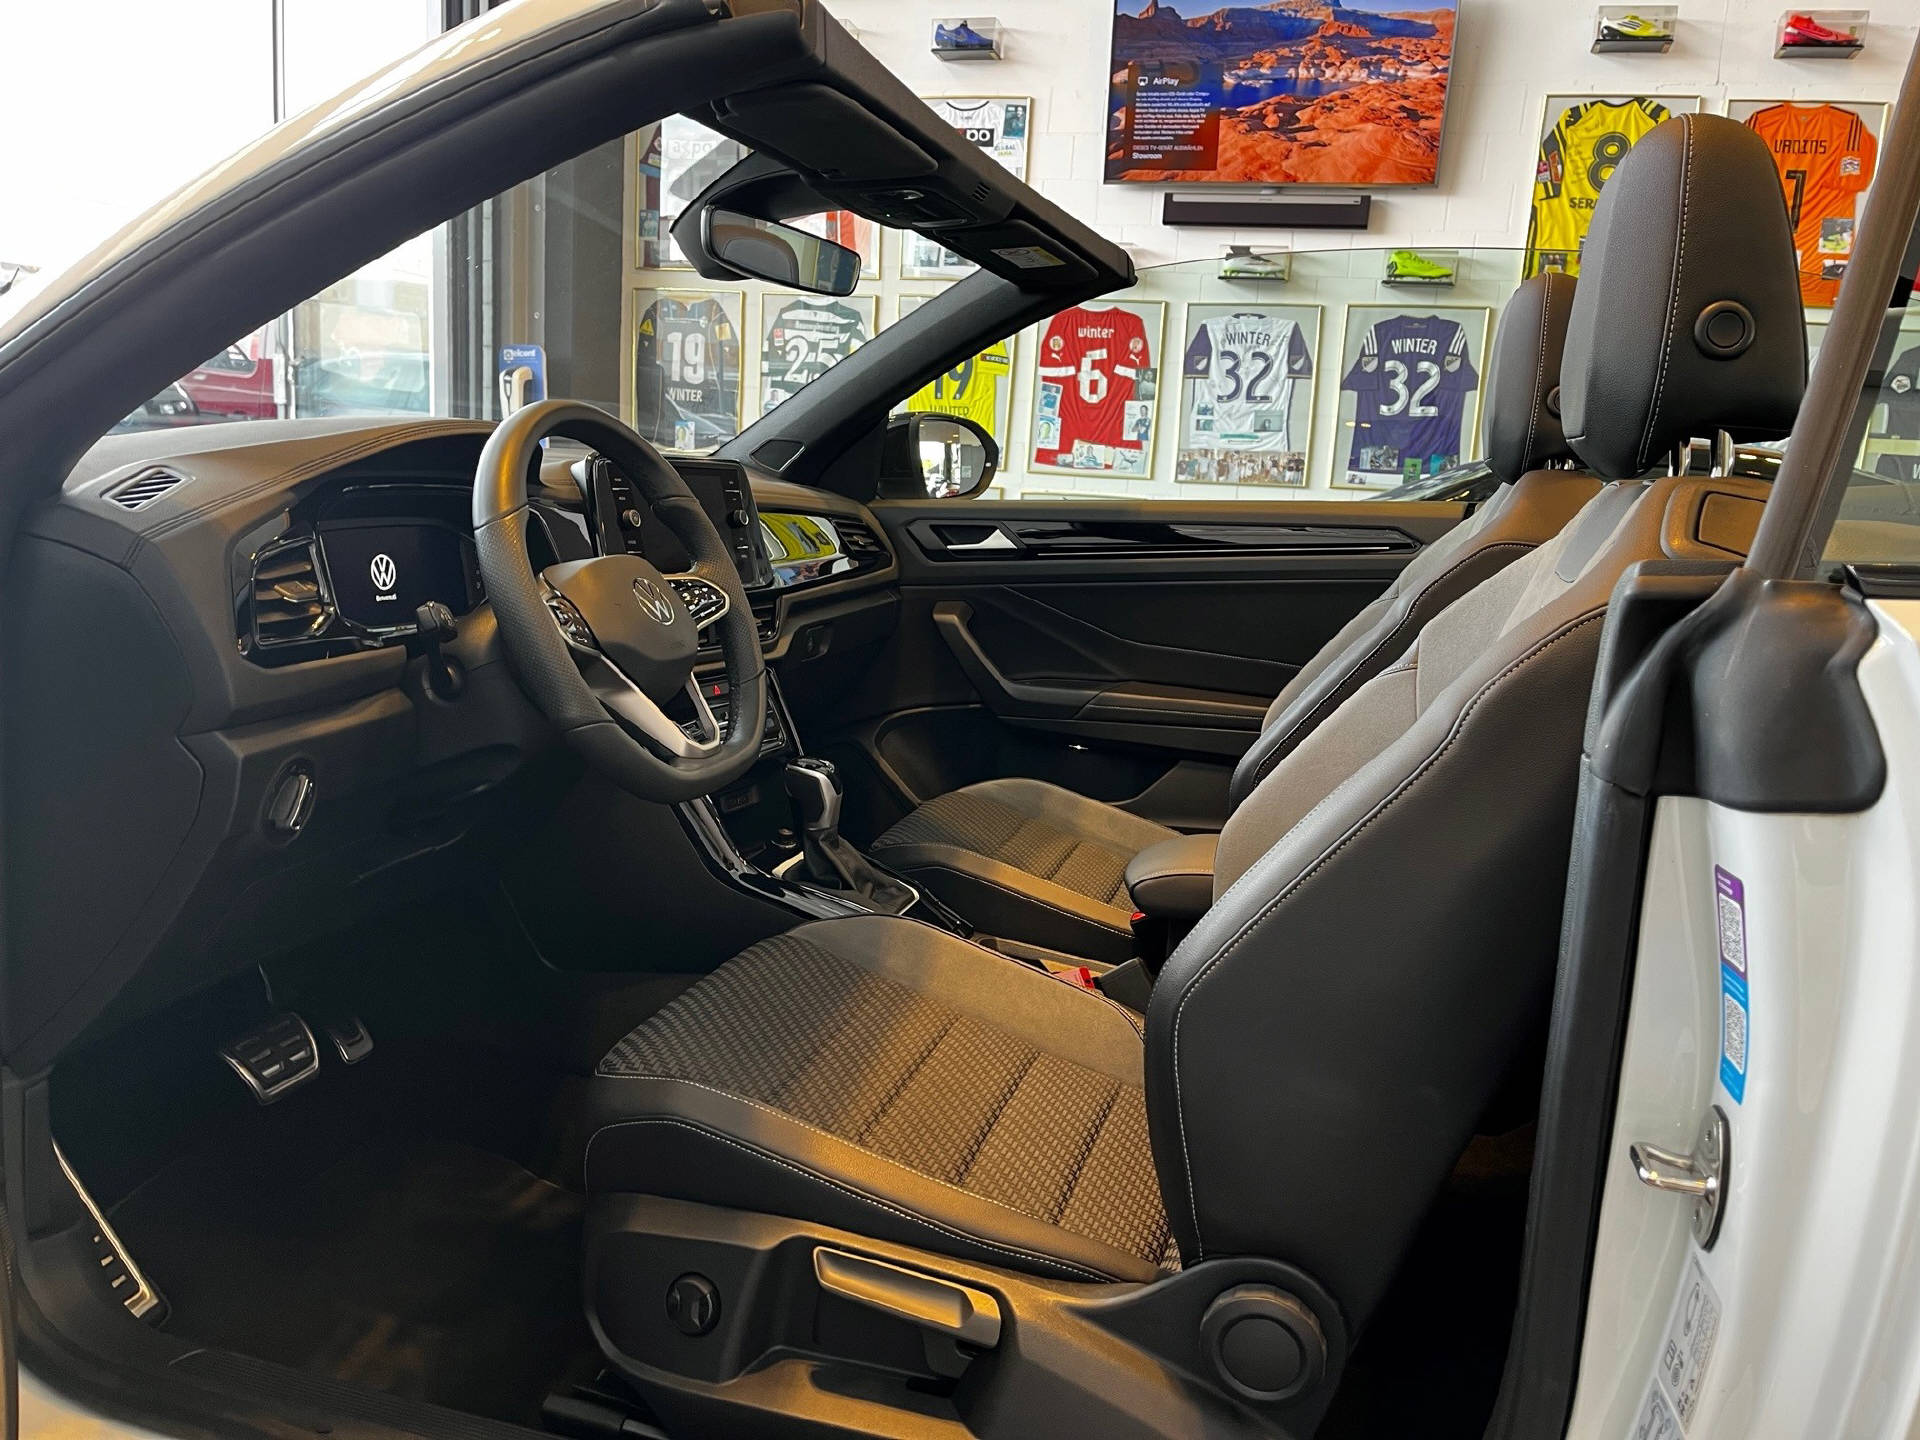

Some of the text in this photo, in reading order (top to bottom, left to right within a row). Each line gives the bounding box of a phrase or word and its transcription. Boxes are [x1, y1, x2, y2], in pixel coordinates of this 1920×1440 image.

[1153, 77, 1180, 87] AirPlay
[1132, 152, 1163, 160] Showroom
[1588, 132, 1632, 193] 8
[1785, 169, 1807, 234] 7
[1078, 327, 1115, 339] winter
[1226, 331, 1271, 347] WINTER
[1391, 338, 1438, 355] WINTER
[667, 331, 706, 385] 19
[783, 335, 840, 384] 25
[1077, 348, 1108, 404] 6
[1216, 351, 1274, 404] 32
[667, 386, 704, 403] WINTER
[1379, 359, 1441, 417] 32
